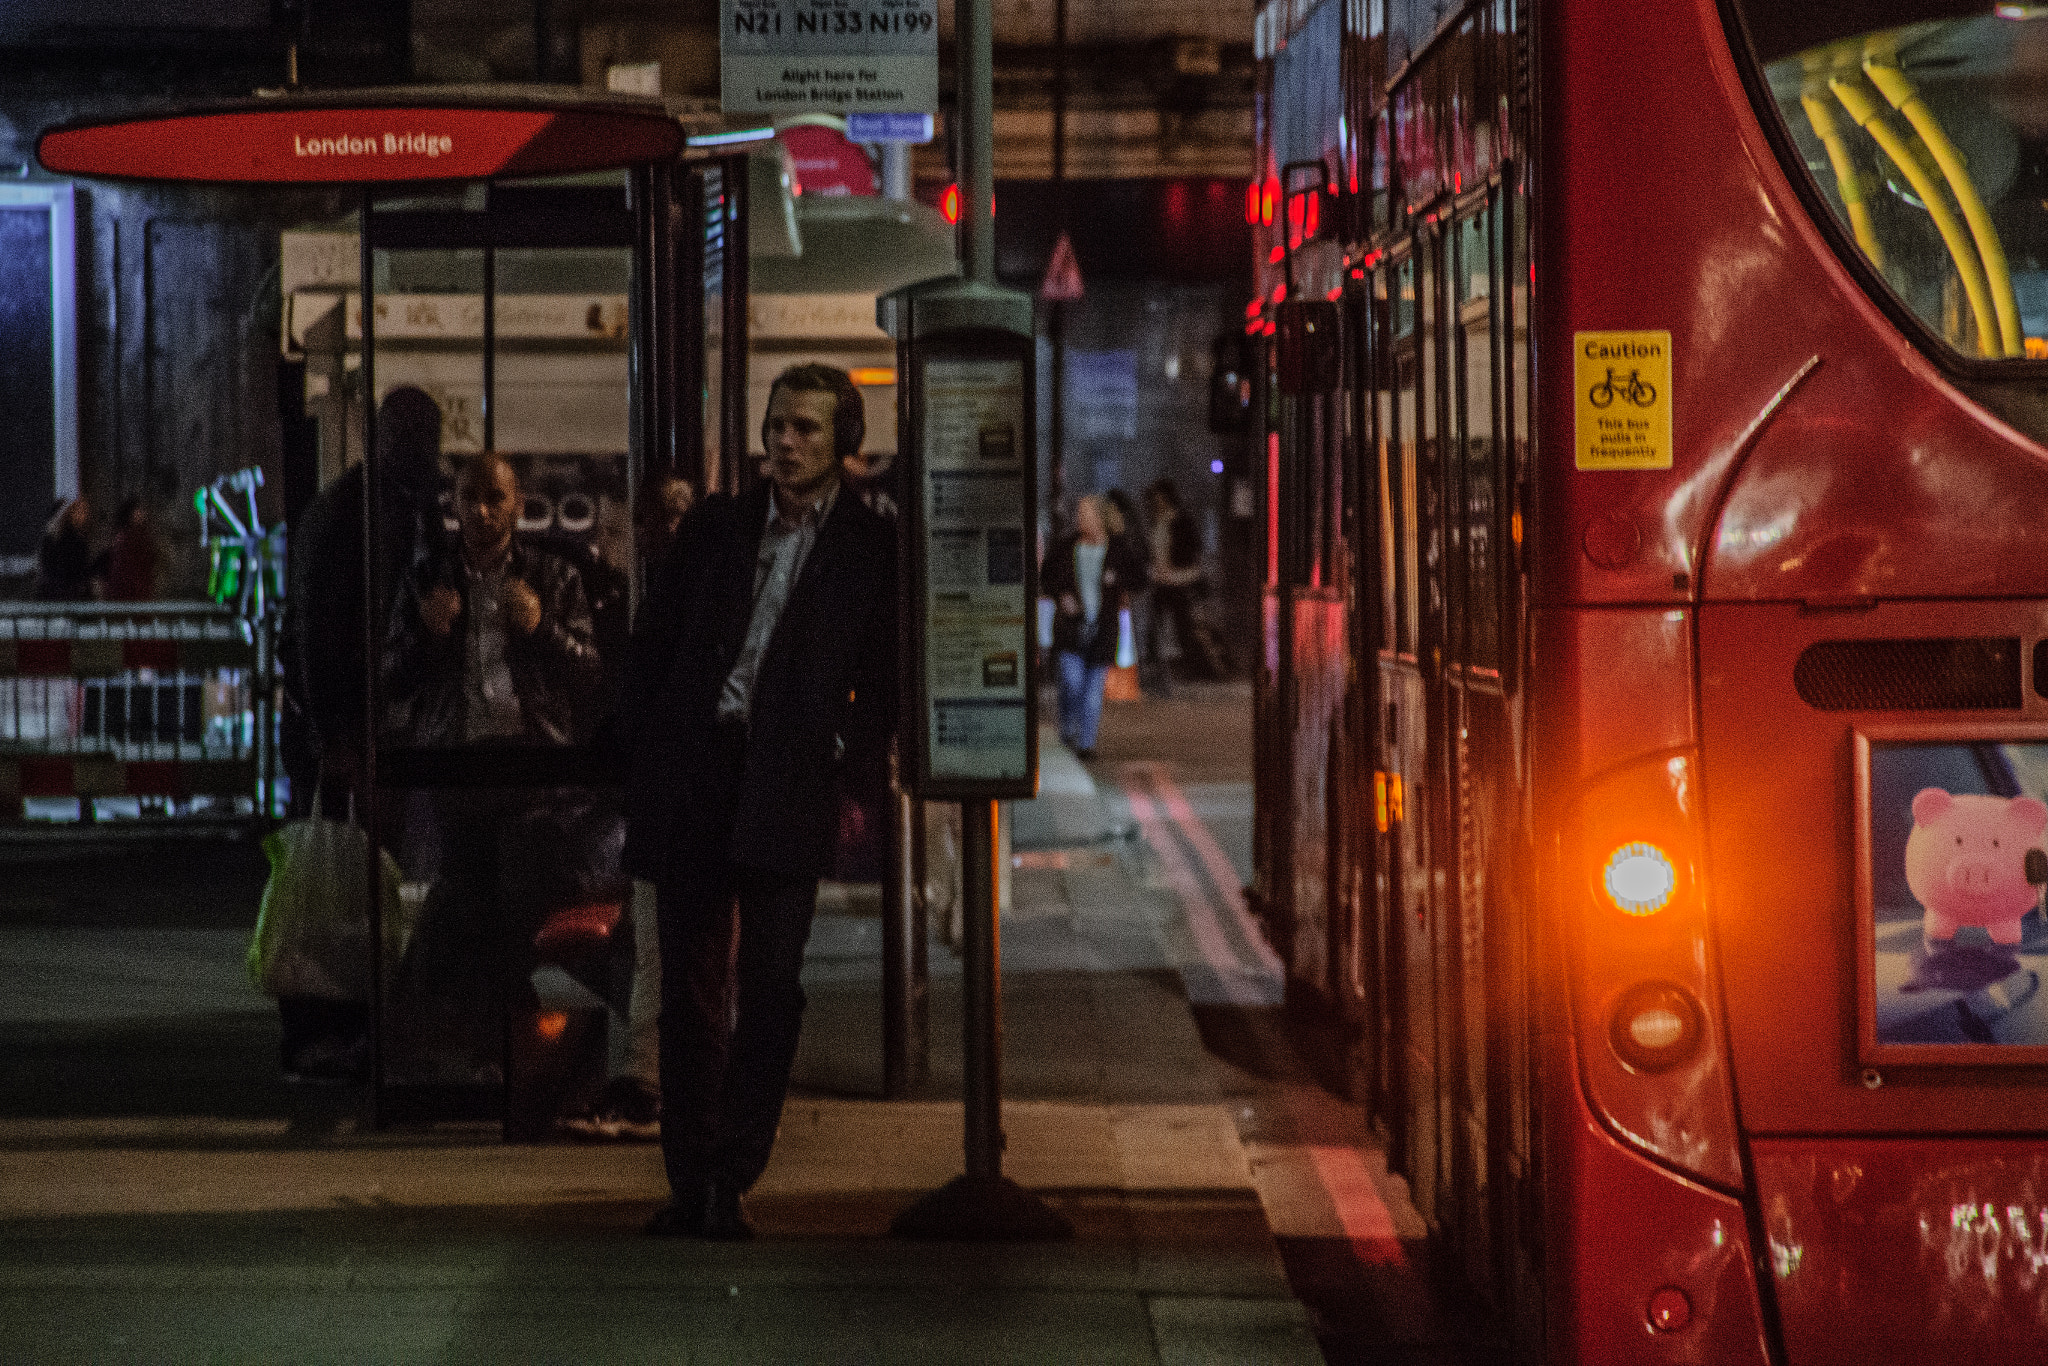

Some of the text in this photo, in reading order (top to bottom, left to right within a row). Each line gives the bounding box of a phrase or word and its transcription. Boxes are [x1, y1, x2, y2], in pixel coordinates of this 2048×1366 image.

[734, 11, 933, 34] N21 N133 N199
[781, 68, 878, 84] Alight here for
[756, 87, 904, 102] London Bridge Station
[295, 131, 453, 158] London Bridge
[1585, 341, 1661, 359] Caution
[1597, 418, 1650, 429] This bus
